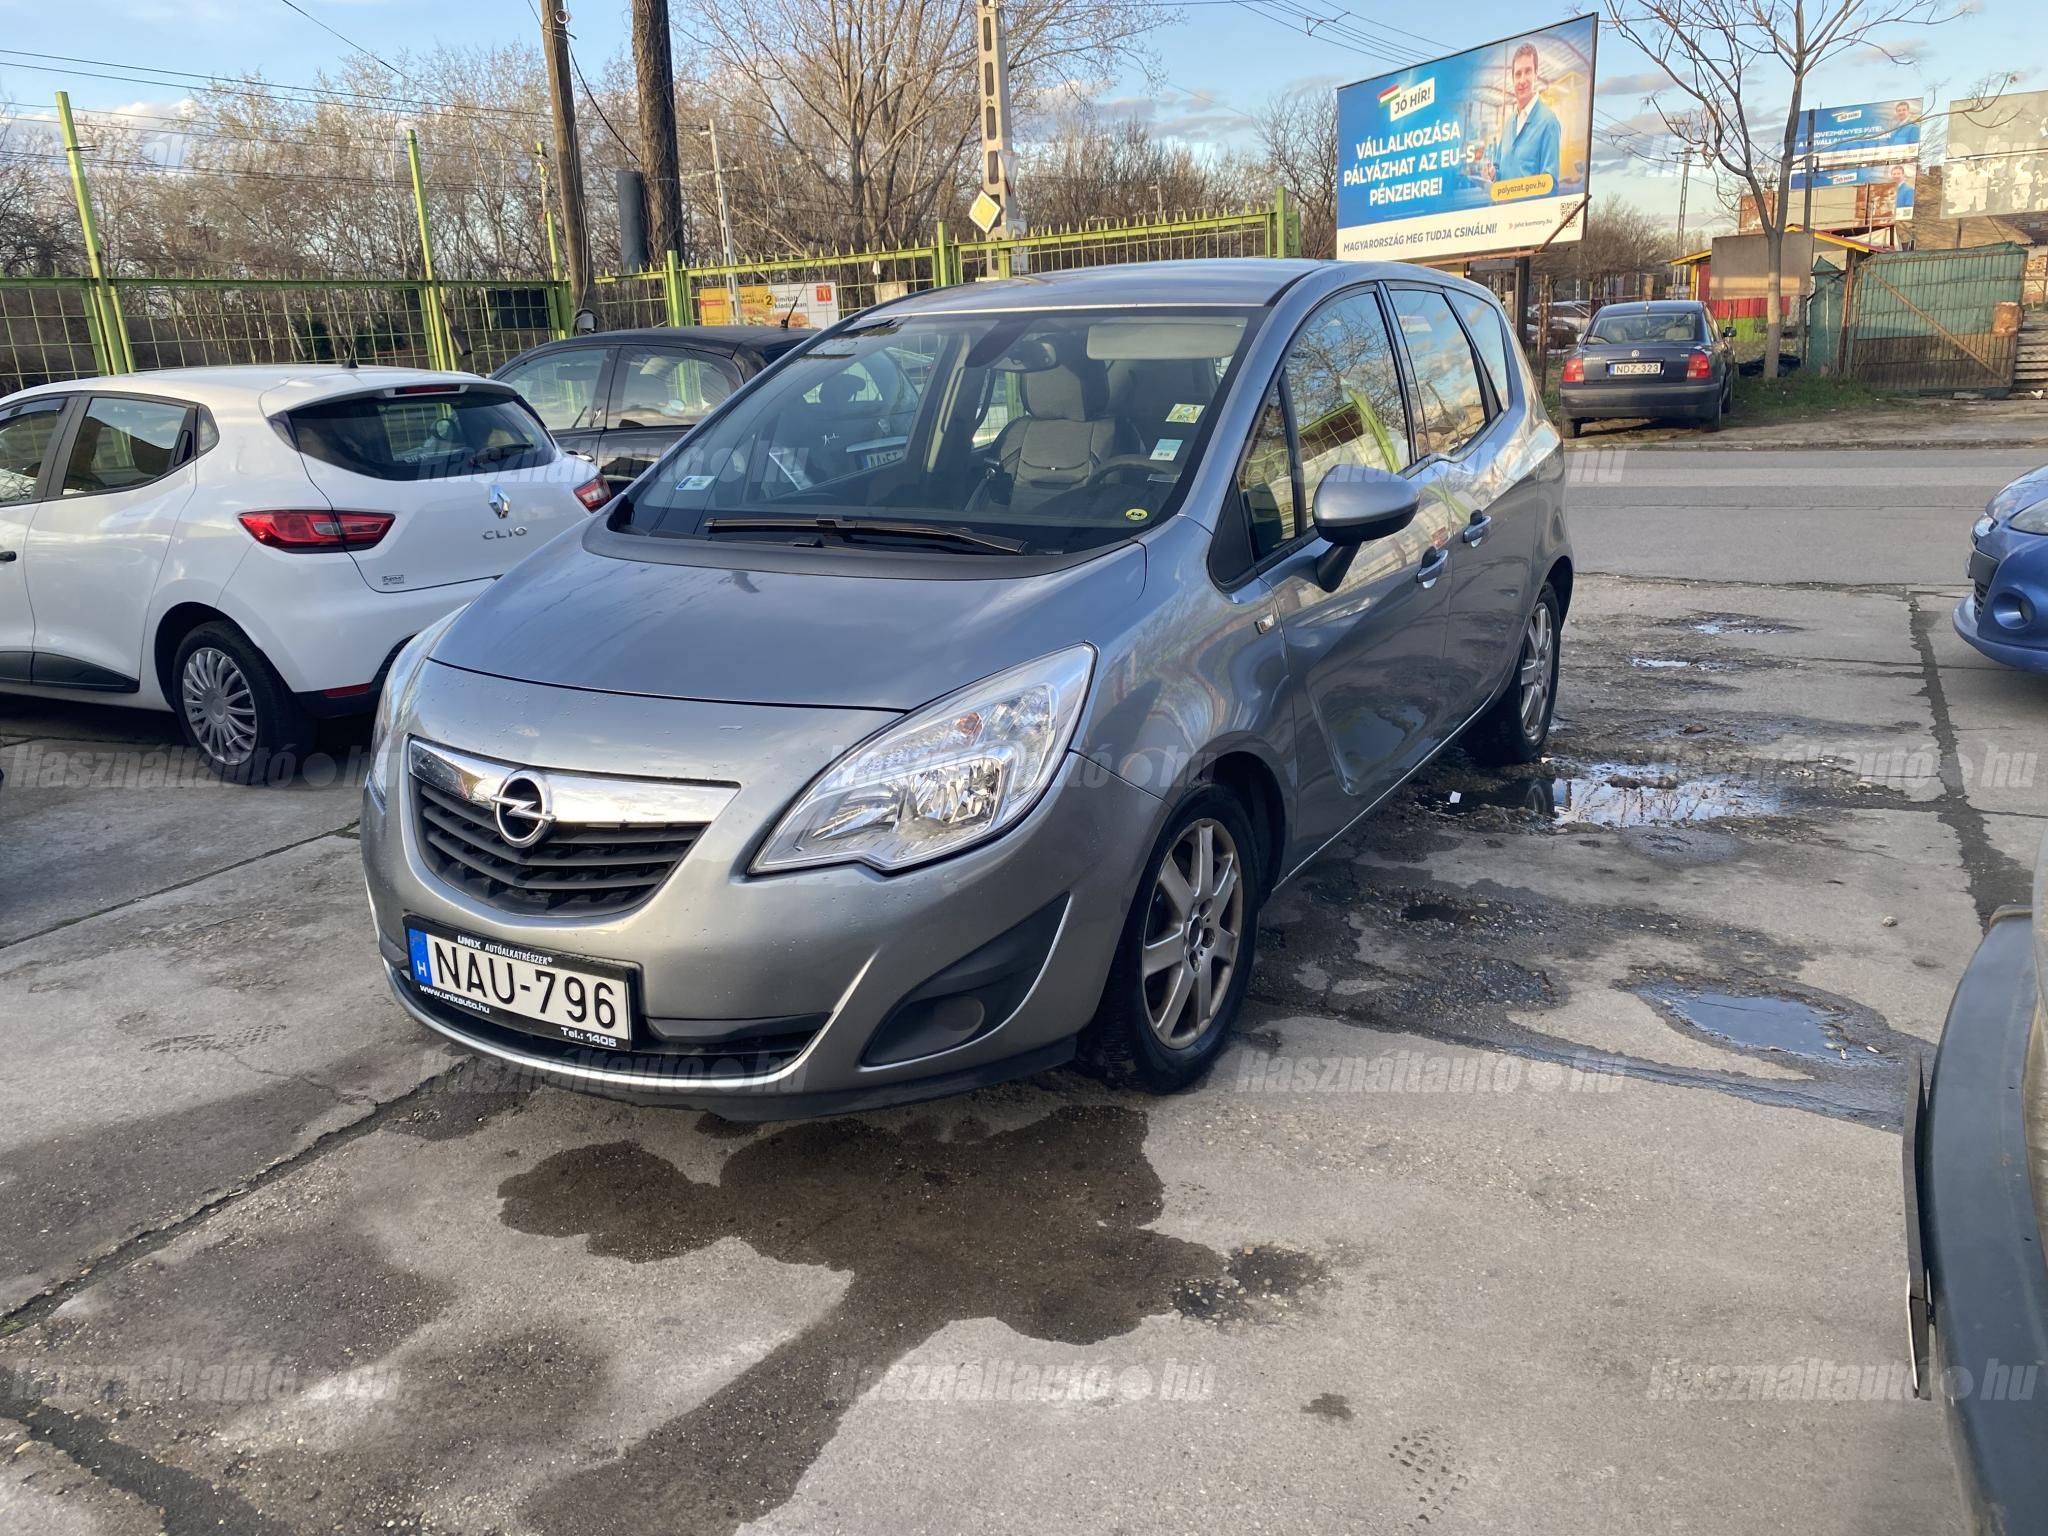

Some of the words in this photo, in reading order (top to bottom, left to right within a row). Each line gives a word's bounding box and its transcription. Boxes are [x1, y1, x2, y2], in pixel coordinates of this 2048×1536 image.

[1394, 97, 1408, 115] JÓ
[1410, 87, 1431, 107] HÍR!
[1356, 120, 1461, 160] VÁLLALKOZÁSA
[1344, 157, 1416, 187] PÁLYÁZHAT
[1418, 153, 1438, 172] AZ
[1440, 145, 1476, 166] EU-S
[1369, 177, 1443, 207] PÉNZEKRE!
[1497, 180, 1547, 197] palyazat.gov.hu
[1343, 234, 1404, 253] MAGYARORSZÁG
[1406, 231, 1424, 245] MEG
[1424, 227, 1452, 243] TUDJA
[1454, 222, 1498, 240] CSINÁLNI!
[1616, 364, 1659, 374] NDZ-323
[482, 526, 529, 541] CLIO
[457, 935, 481, 950] UNIX
[417, 960, 427, 978] H
[434, 941, 617, 1030] NAU-796
[419, 984, 490, 1015] www.unixauto.hu
[561, 1026, 584, 1041] Tel.:
[586, 1032, 617, 1048] 1405
